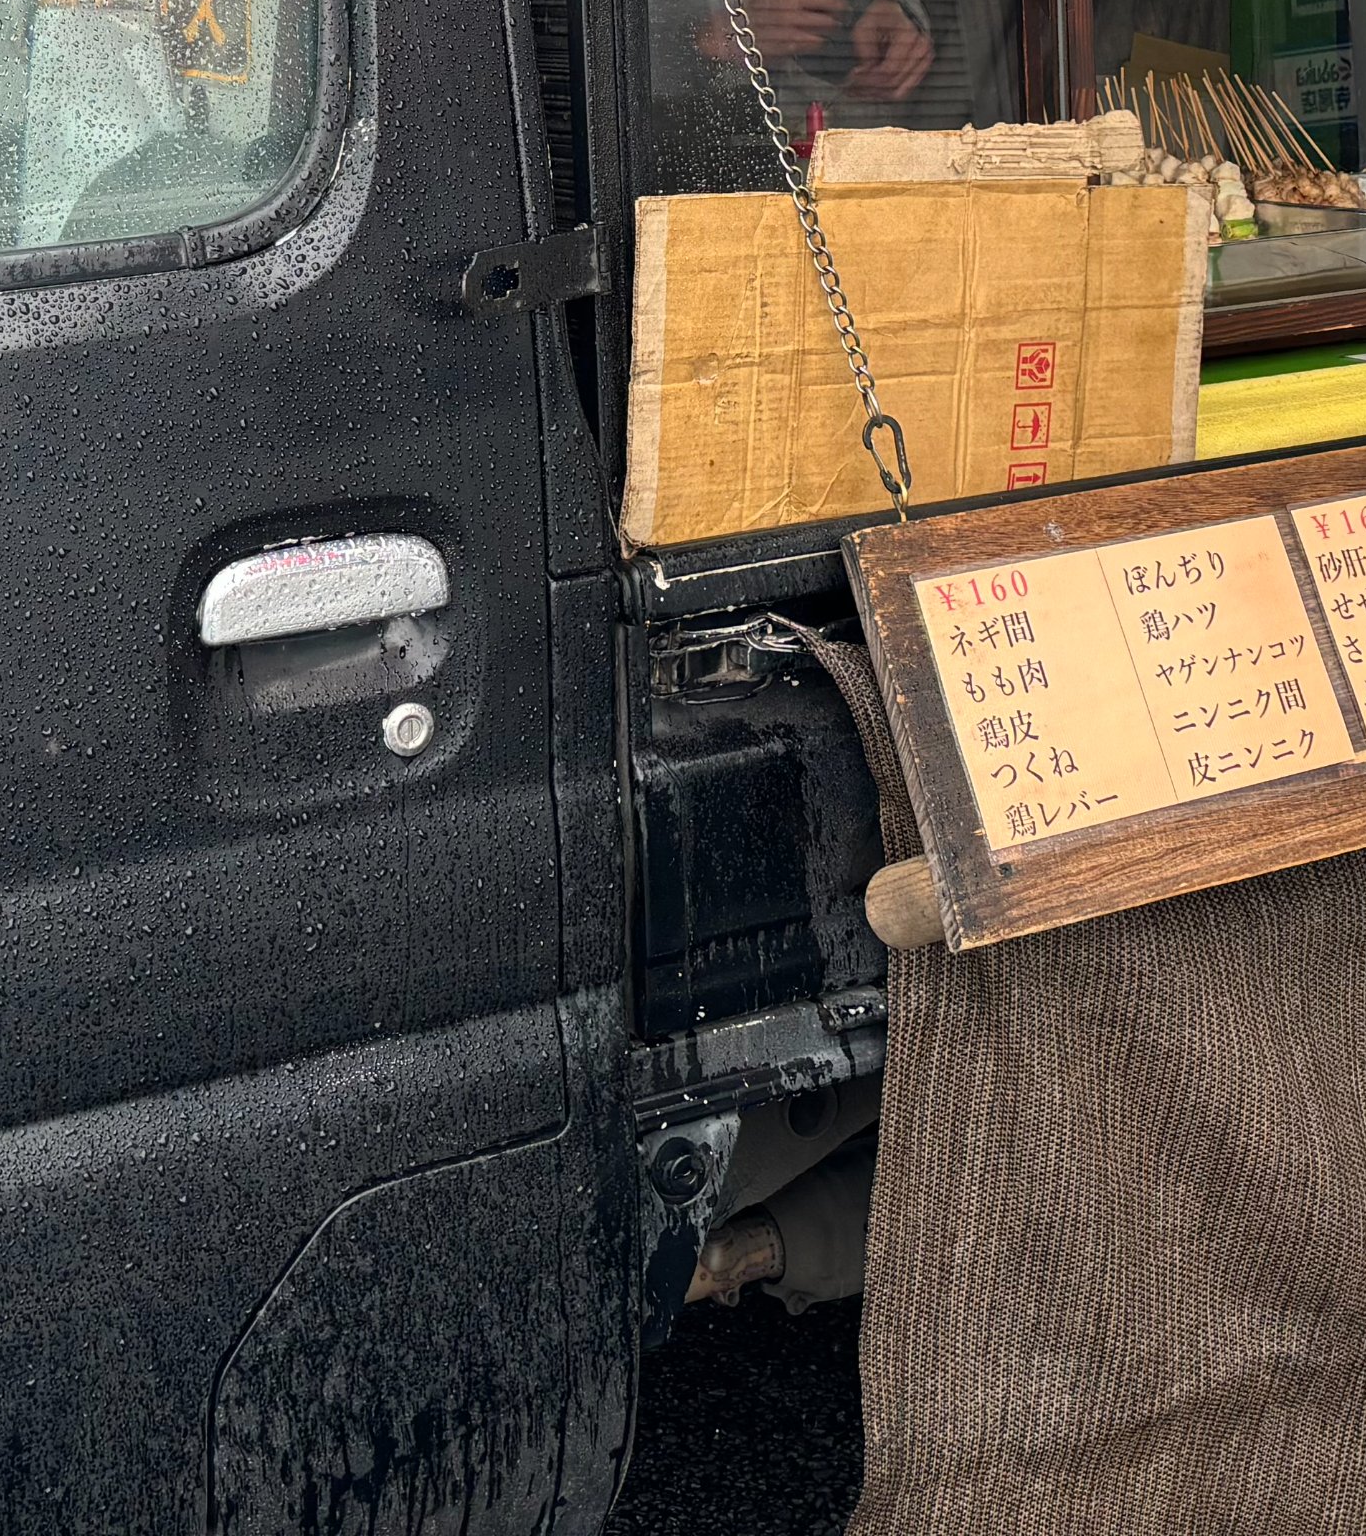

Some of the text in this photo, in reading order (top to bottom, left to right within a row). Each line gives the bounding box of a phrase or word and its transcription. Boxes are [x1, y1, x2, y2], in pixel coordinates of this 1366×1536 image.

[935, 569, 1029, 612] ¥160
[1124, 549, 1226, 595] ぼんぢり
[949, 610, 1036, 658] ネギ間
[1139, 601, 1218, 645] 鶏ハツ
[963, 658, 1050, 703] もも肉
[1154, 634, 1306, 689] ヤゲンナンコツ
[1172, 677, 1307, 734] ニンニク間
[976, 708, 1041, 754] 鶏皮
[990, 746, 1080, 788] つくね
[1188, 728, 1317, 788] 皮ニンニク
[1004, 791, 1121, 841] 鶏レバー
